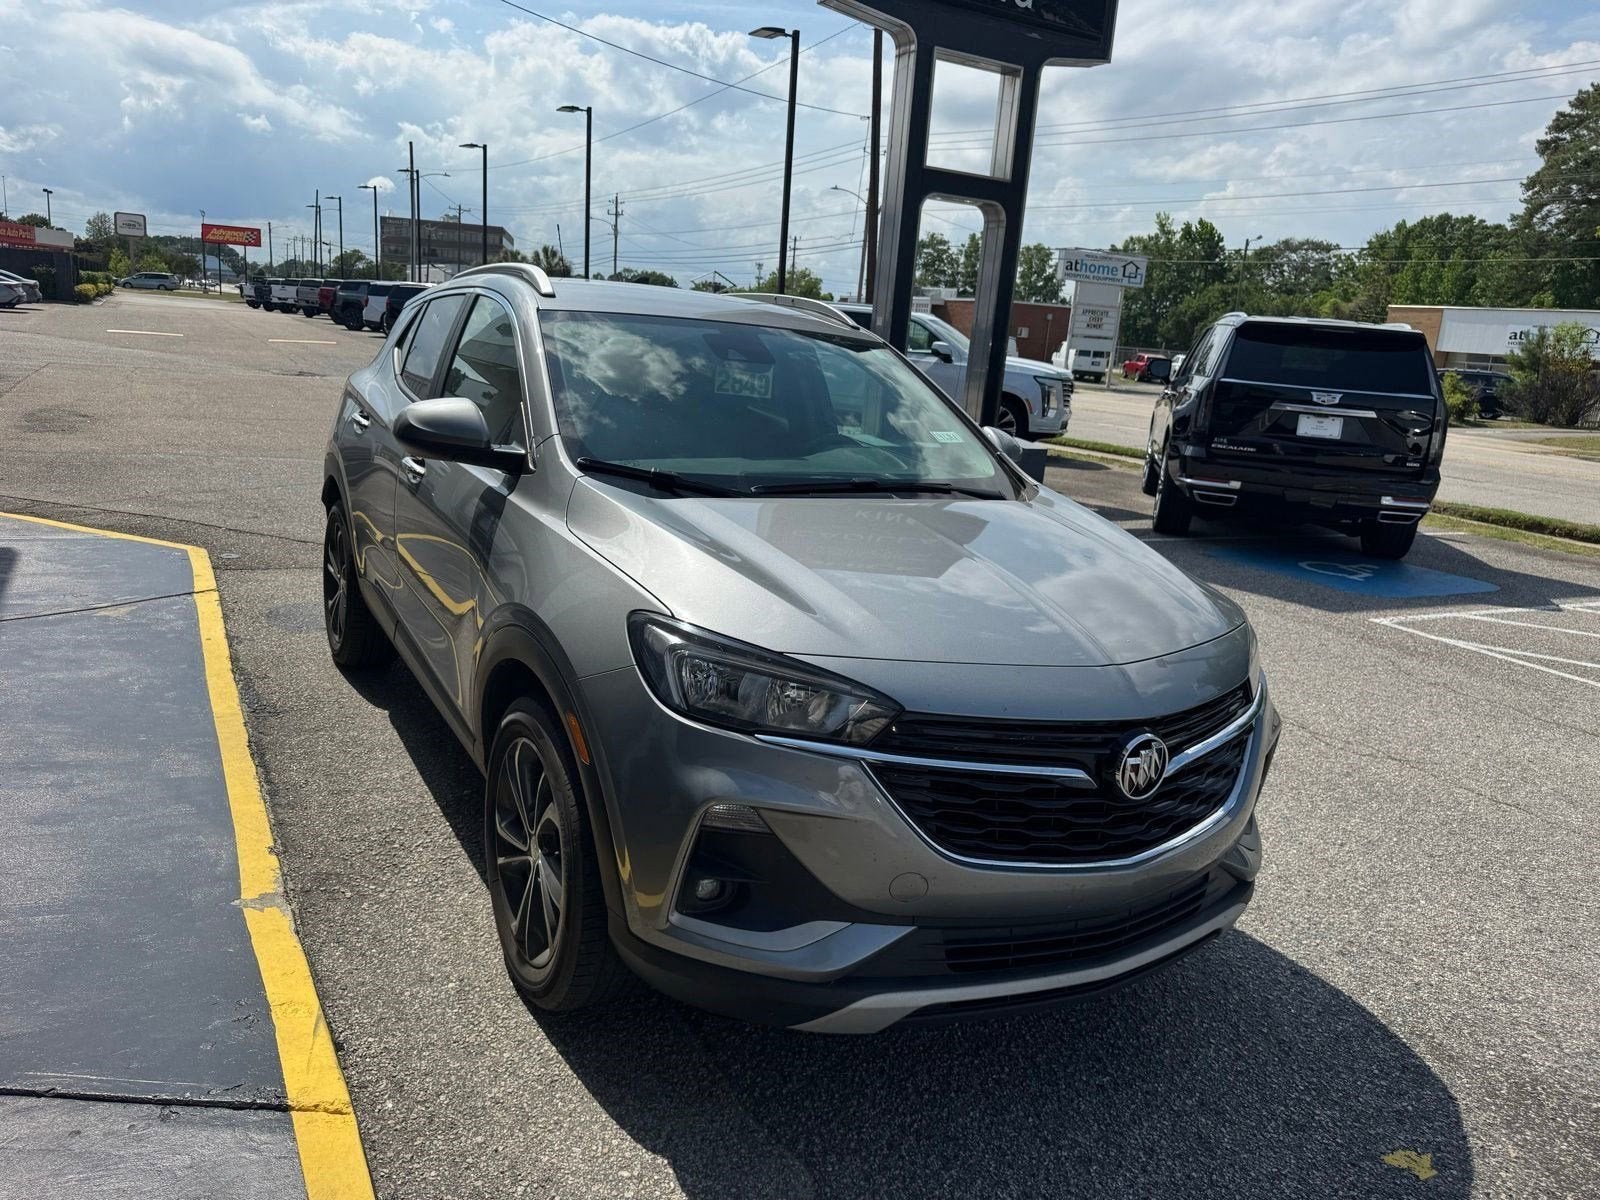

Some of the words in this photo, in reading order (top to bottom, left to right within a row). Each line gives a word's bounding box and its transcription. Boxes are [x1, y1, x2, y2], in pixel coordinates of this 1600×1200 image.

[1065, 259, 1119, 276] athome
[1064, 272, 1090, 280] HOSPITAL
[1092, 274, 1124, 283] EQUIPMENT
